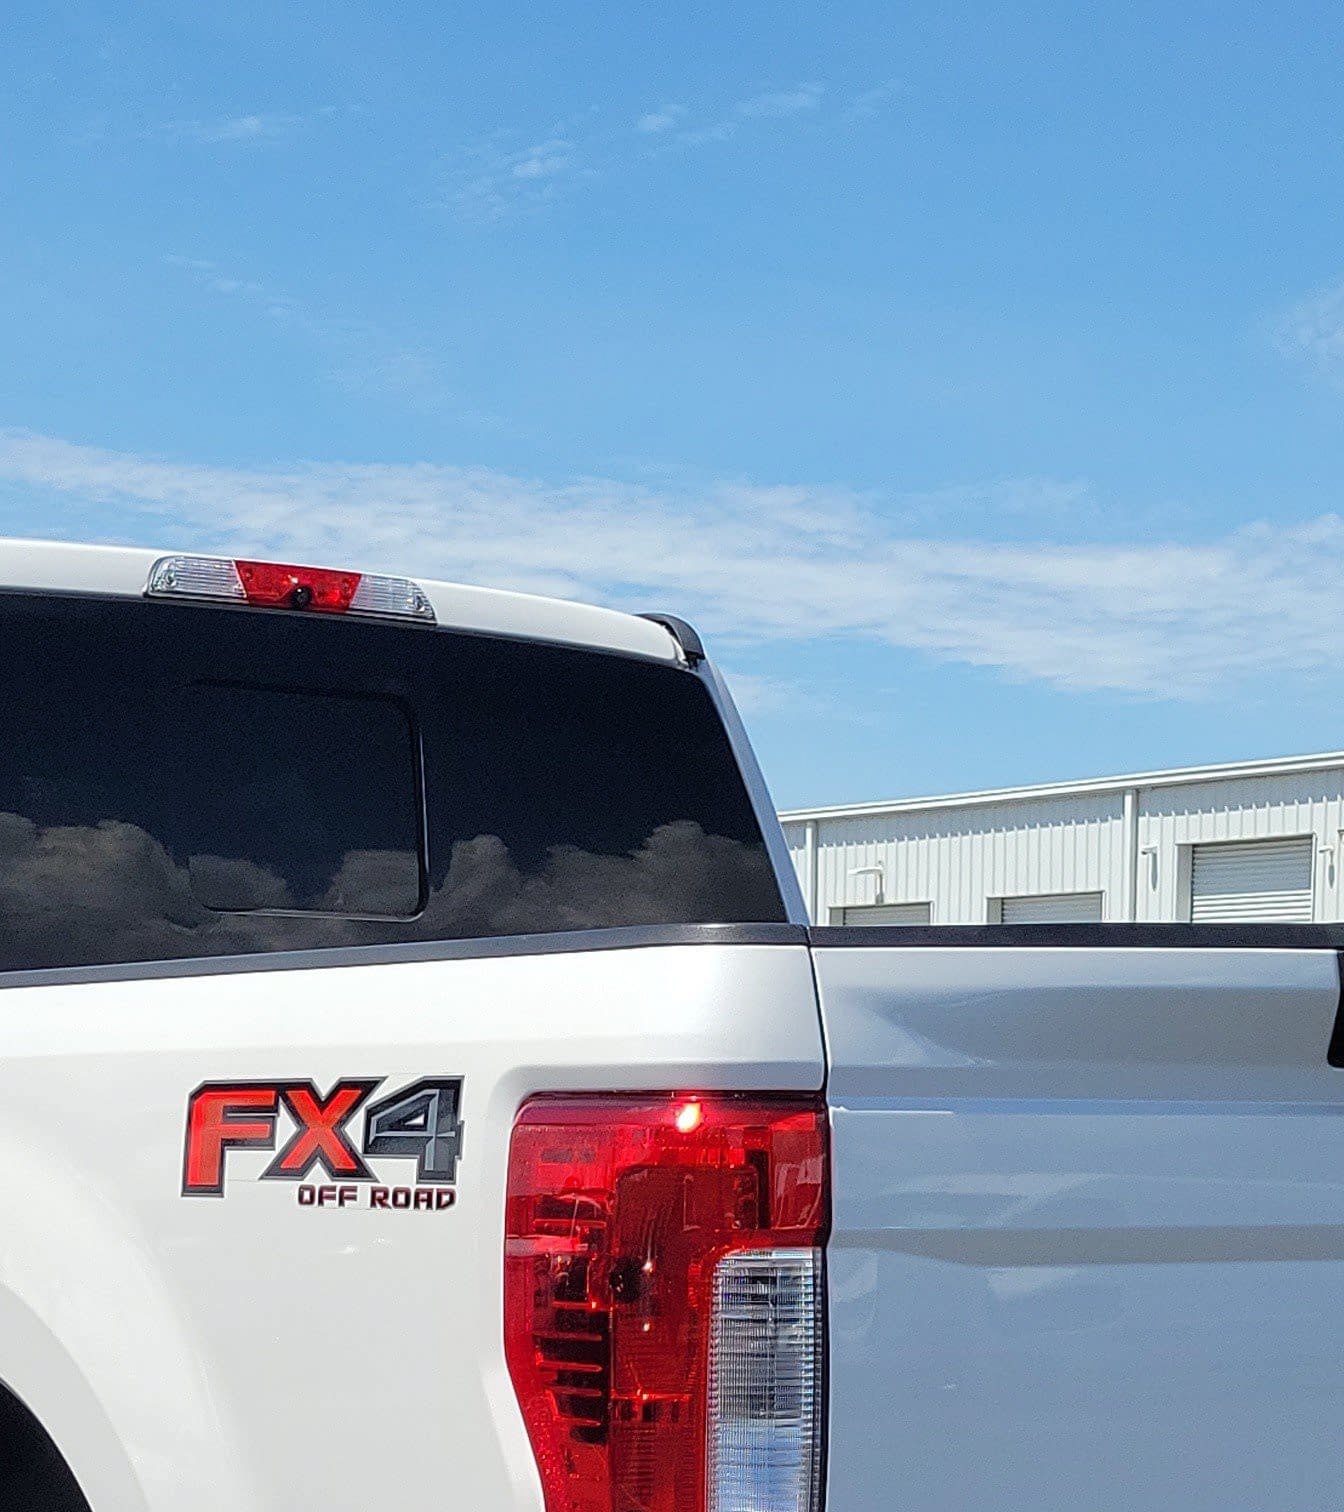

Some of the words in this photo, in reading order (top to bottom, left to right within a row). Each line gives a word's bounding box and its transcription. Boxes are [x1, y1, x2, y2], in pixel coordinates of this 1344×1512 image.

[181, 1076, 465, 1197] FX4
[297, 1184, 358, 1206] OFF
[370, 1186, 456, 1209] ROAD
